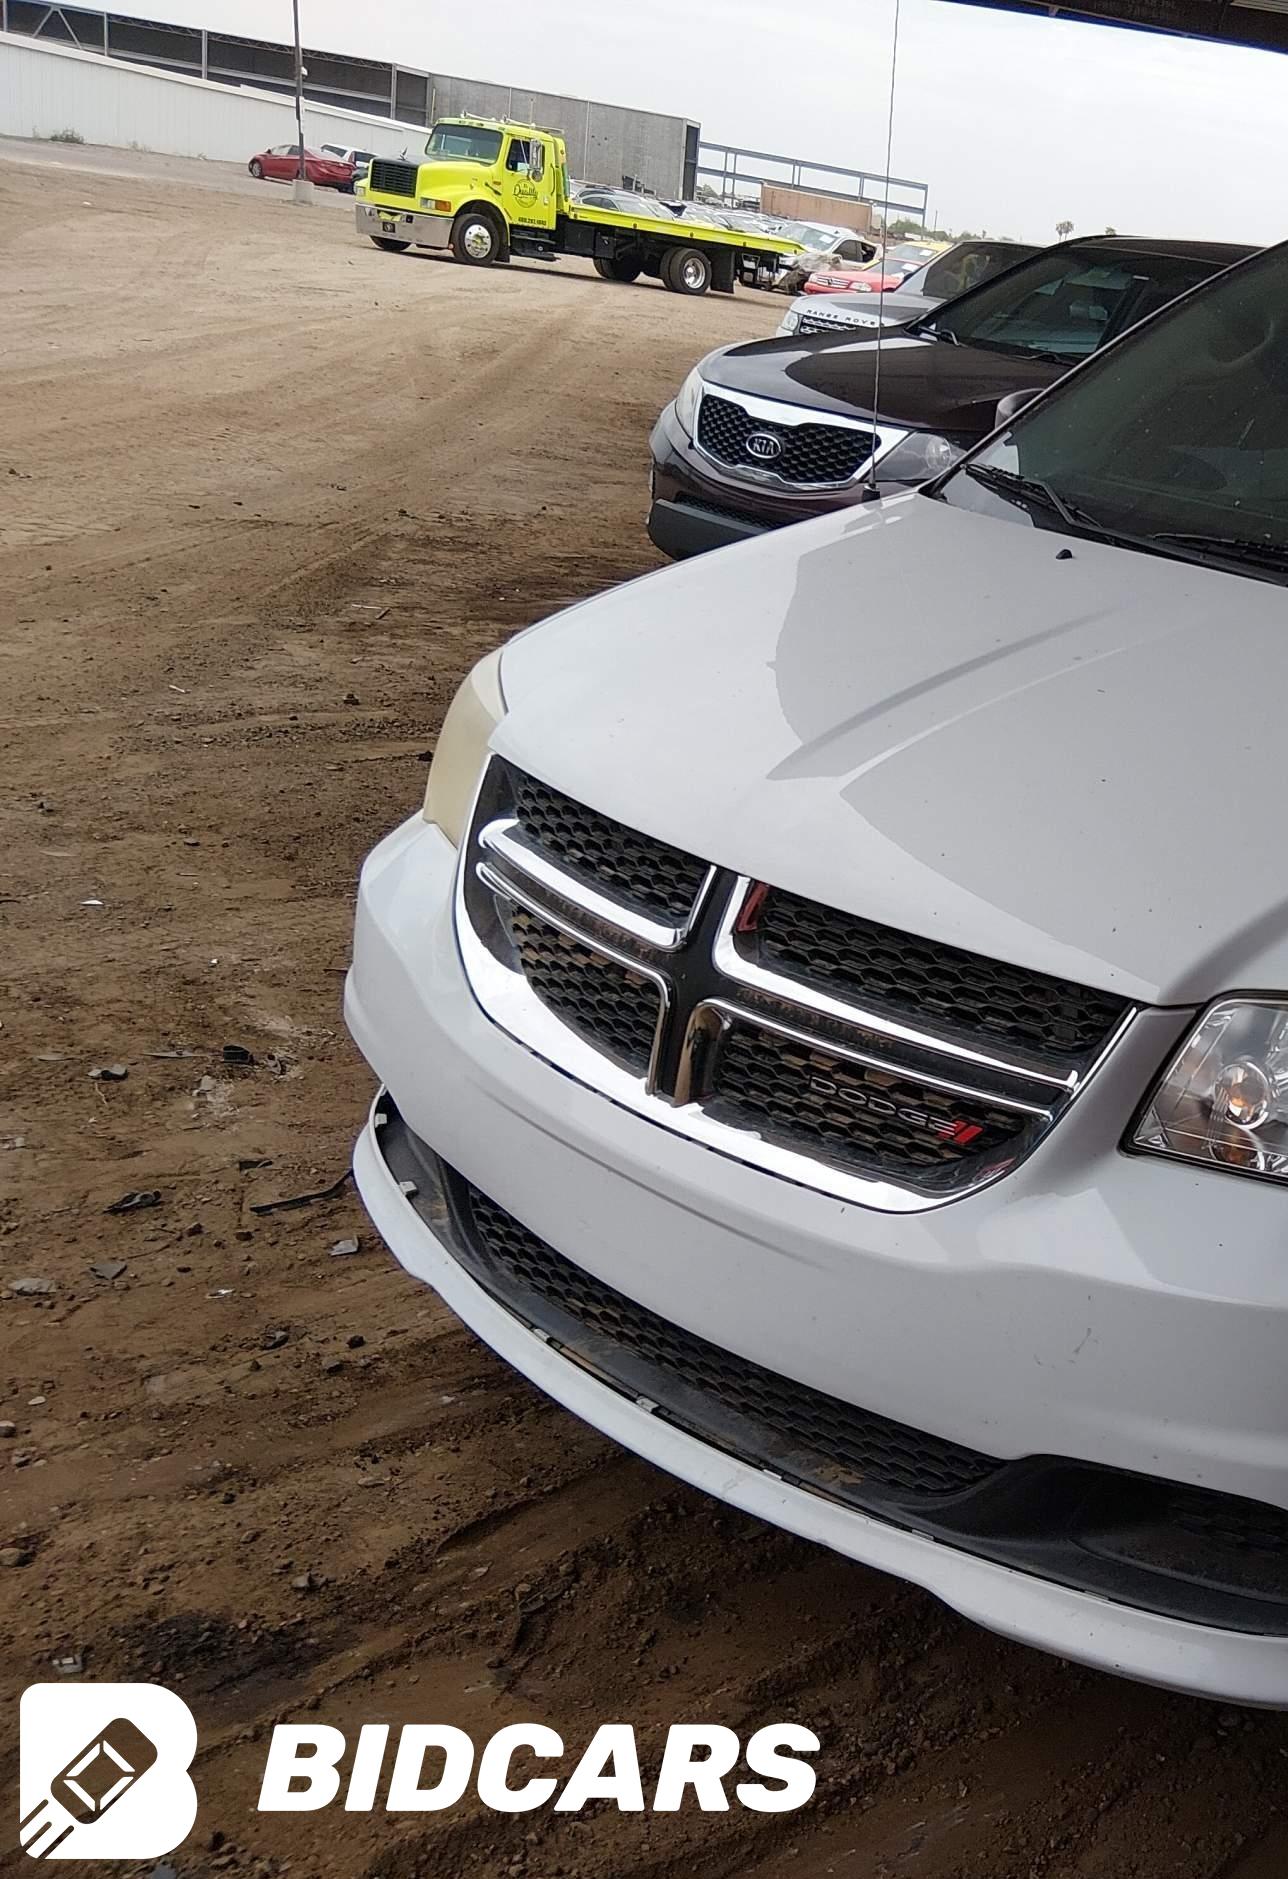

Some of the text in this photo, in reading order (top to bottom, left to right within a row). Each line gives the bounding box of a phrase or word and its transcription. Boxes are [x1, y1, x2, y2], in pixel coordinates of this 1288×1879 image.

[806, 308, 840, 319] RANGE
[752, 437, 775, 456] KIA
[809, 1075, 957, 1137] DODGE
